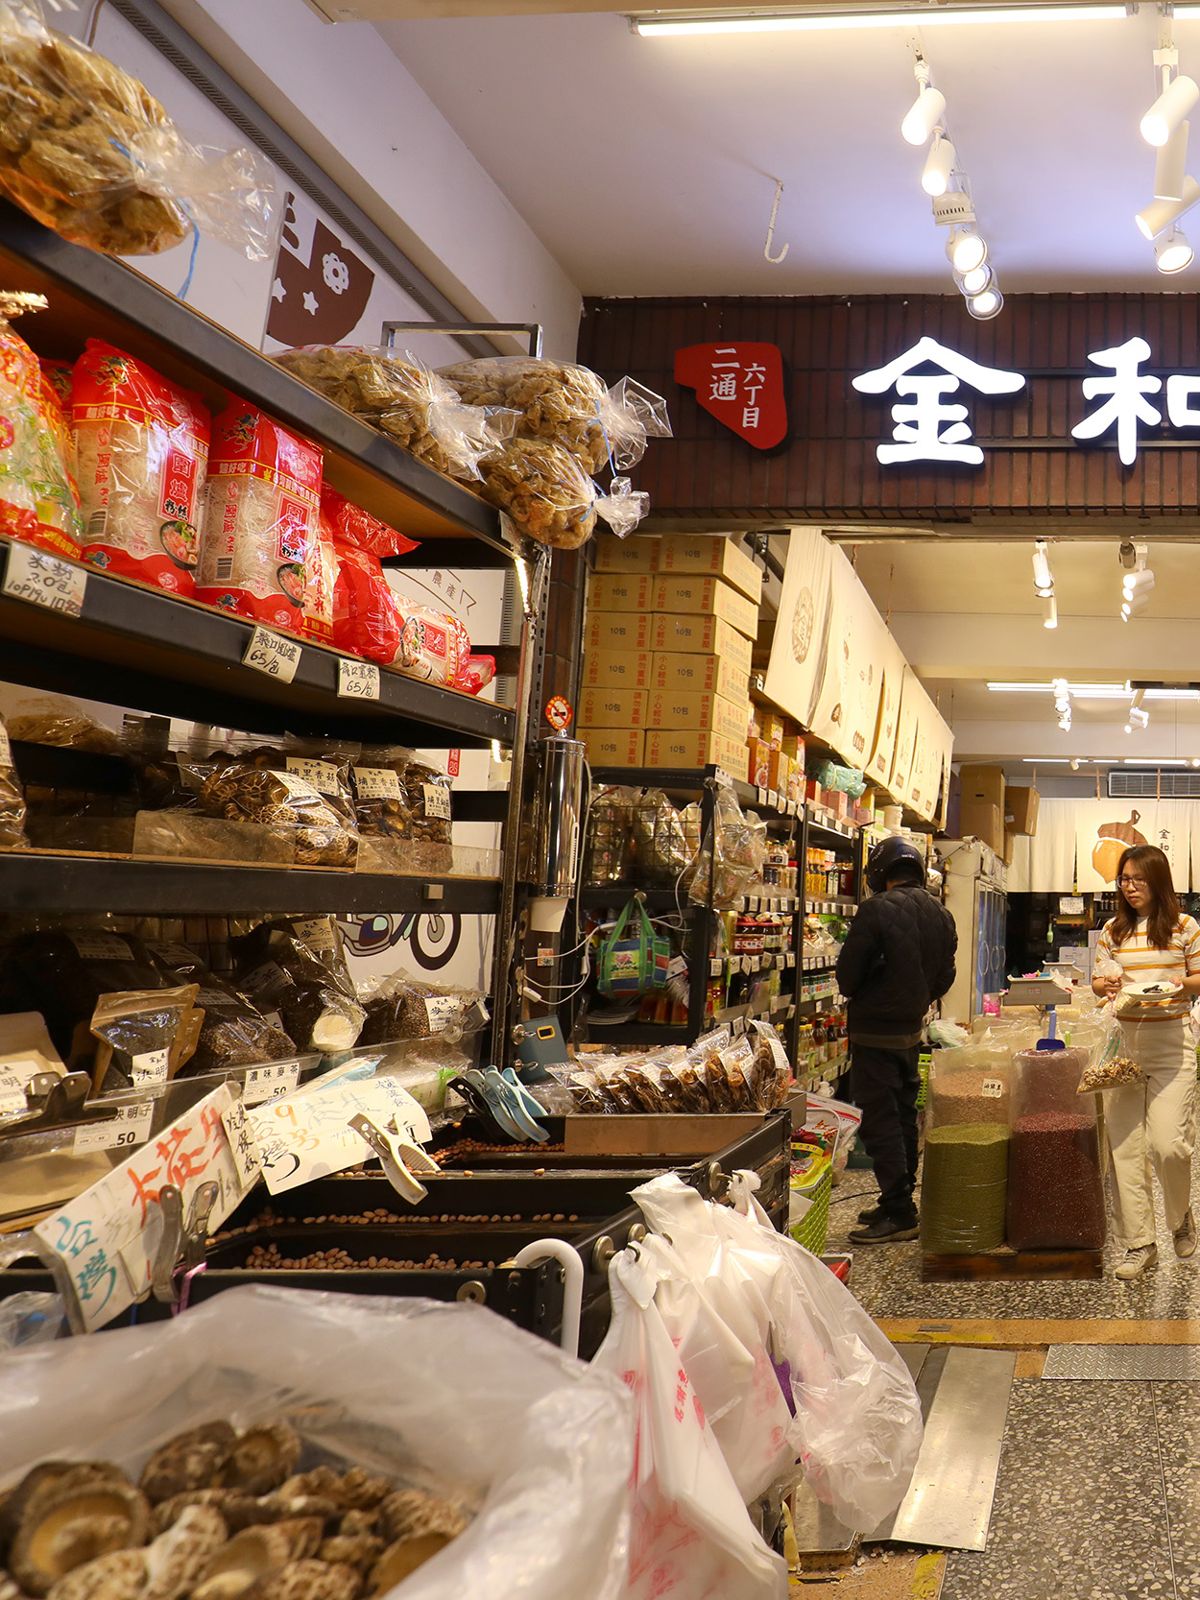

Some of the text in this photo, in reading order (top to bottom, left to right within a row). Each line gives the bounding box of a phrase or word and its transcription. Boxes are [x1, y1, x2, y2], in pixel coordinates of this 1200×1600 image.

[709, 348, 741, 401] 二通
[742, 362, 767, 428] 六丁目
[249, 1064, 299, 1081] 濃味麥茶
[273, 1086, 287, 1097] 50
[116, 1131, 136, 1146] 50
[57, 1215, 118, 1318] 台灣
